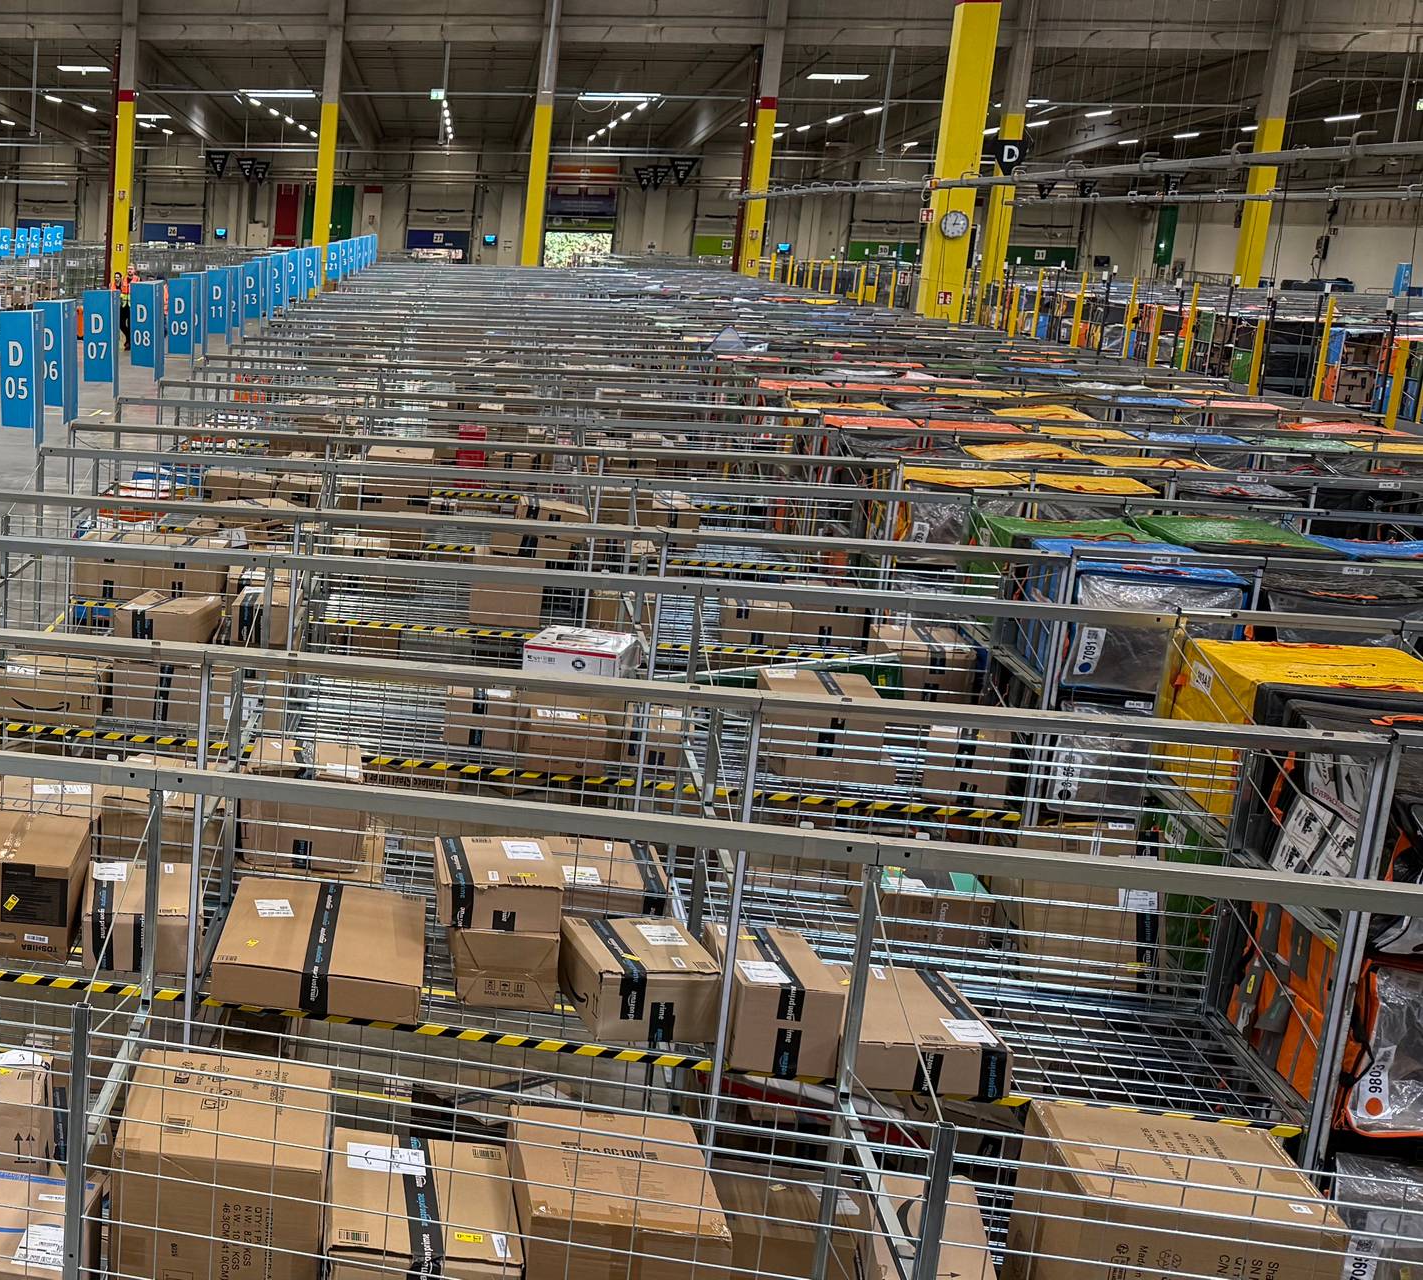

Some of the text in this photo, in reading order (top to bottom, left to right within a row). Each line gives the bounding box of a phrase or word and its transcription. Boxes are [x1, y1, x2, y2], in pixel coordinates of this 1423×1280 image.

[1003, 145, 1019, 163] D
[2, 234, 8, 242] C
[19, 234, 24, 242] C
[32, 234, 38, 242] C
[46, 232, 52, 240] C
[306, 258, 312, 267] D
[331, 252, 337, 260] D
[246, 276, 254, 289] D
[212, 284, 222, 300] D
[244, 294, 257, 304] 13
[136, 304, 148, 322] D
[174, 298, 185, 314] D
[210, 306, 223, 318] 11
[90, 314, 104, 334] D
[171, 321, 188, 336] 09
[134, 330, 150, 346] 08
[8, 341, 24, 367] D
[88, 342, 107, 360] 07
[5, 377, 28, 400] 05
[1082, 641, 1097, 660] 7091
[21, 943, 57, 953] TOSHIBA
[1369, 1065, 1384, 1093] 9803
[232, 1251, 240, 1270] KGS
